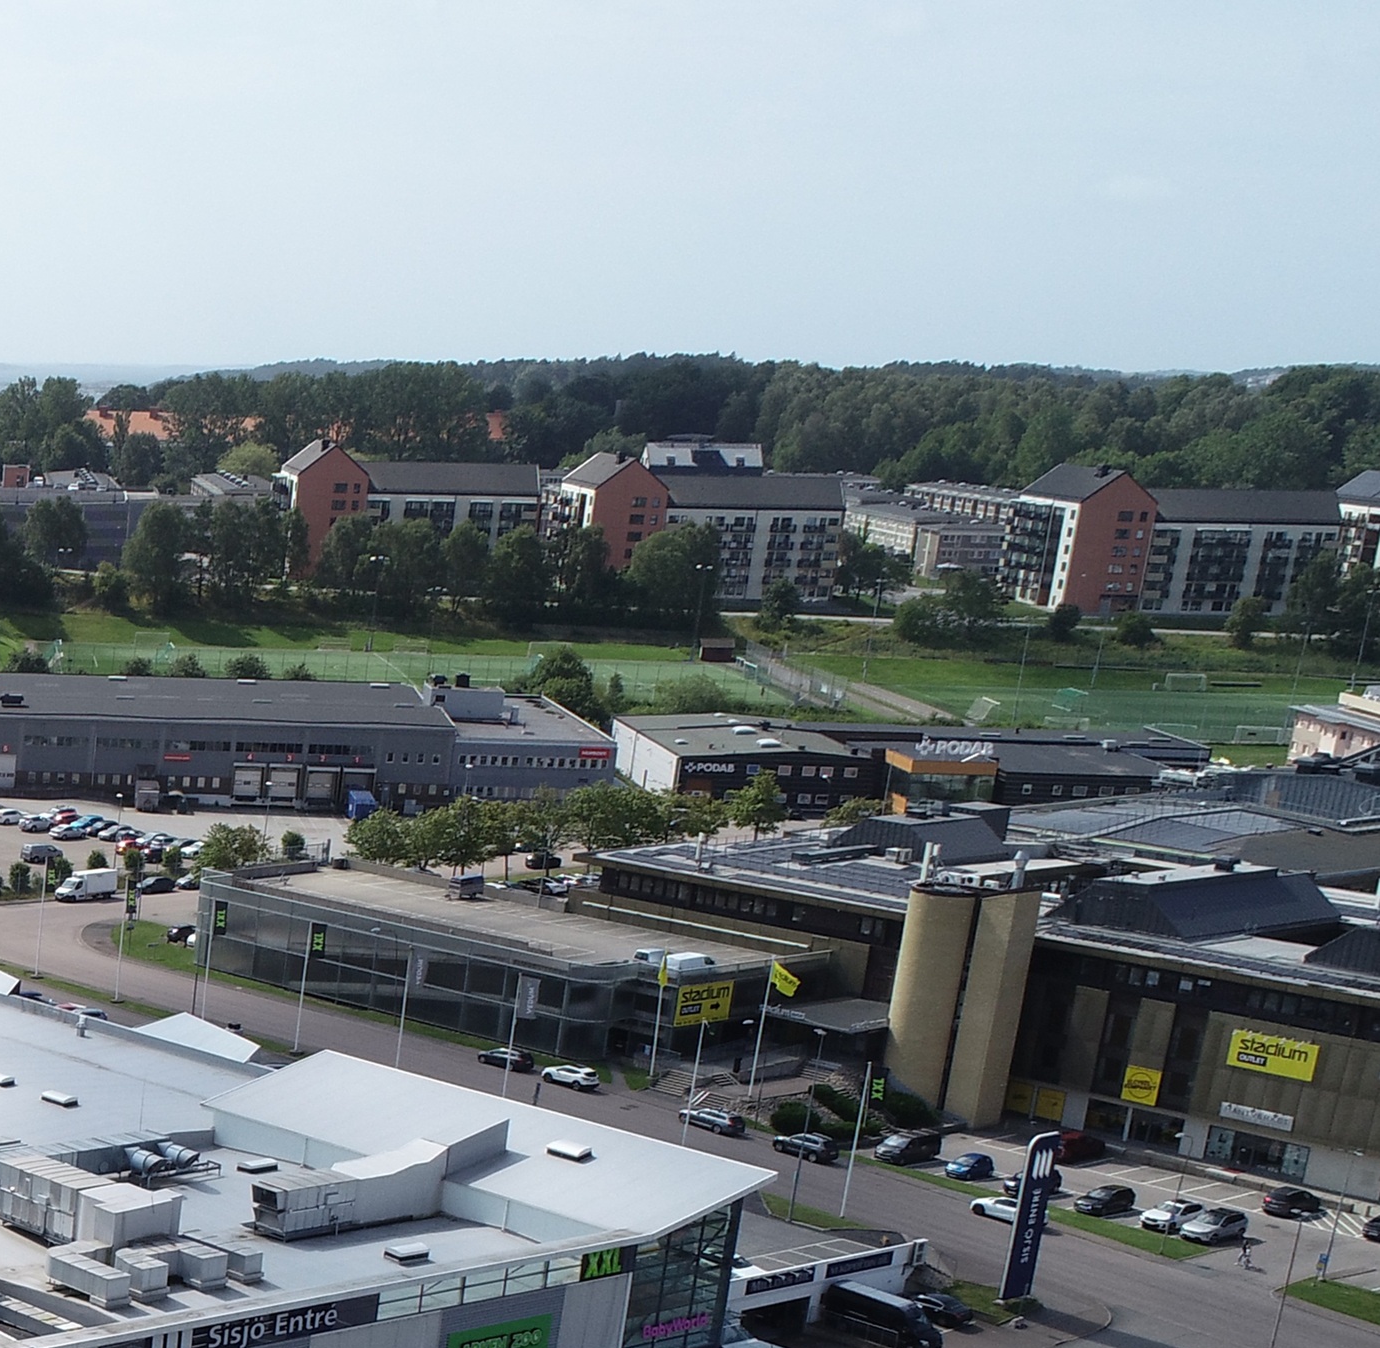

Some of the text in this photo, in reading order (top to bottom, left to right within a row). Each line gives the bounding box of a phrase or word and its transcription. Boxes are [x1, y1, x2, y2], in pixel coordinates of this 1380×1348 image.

[935, 740, 994, 756] PODAB
[696, 763, 735, 772] PODAB
[216, 909, 226, 928] XXL
[312, 932, 324, 951] XXL
[681, 985, 730, 1004] stadium
[1239, 1037, 1309, 1063] stadium
[1238, 1054, 1266, 1066] OUTLET
[871, 1078, 885, 1100] XXL
[584, 1247, 622, 1279] XXL
[208, 1303, 338, 1348] Sisjö Entré
[643, 1312, 708, 1339] BabyWorld
[510, 1328, 542, 1348] ZOO
